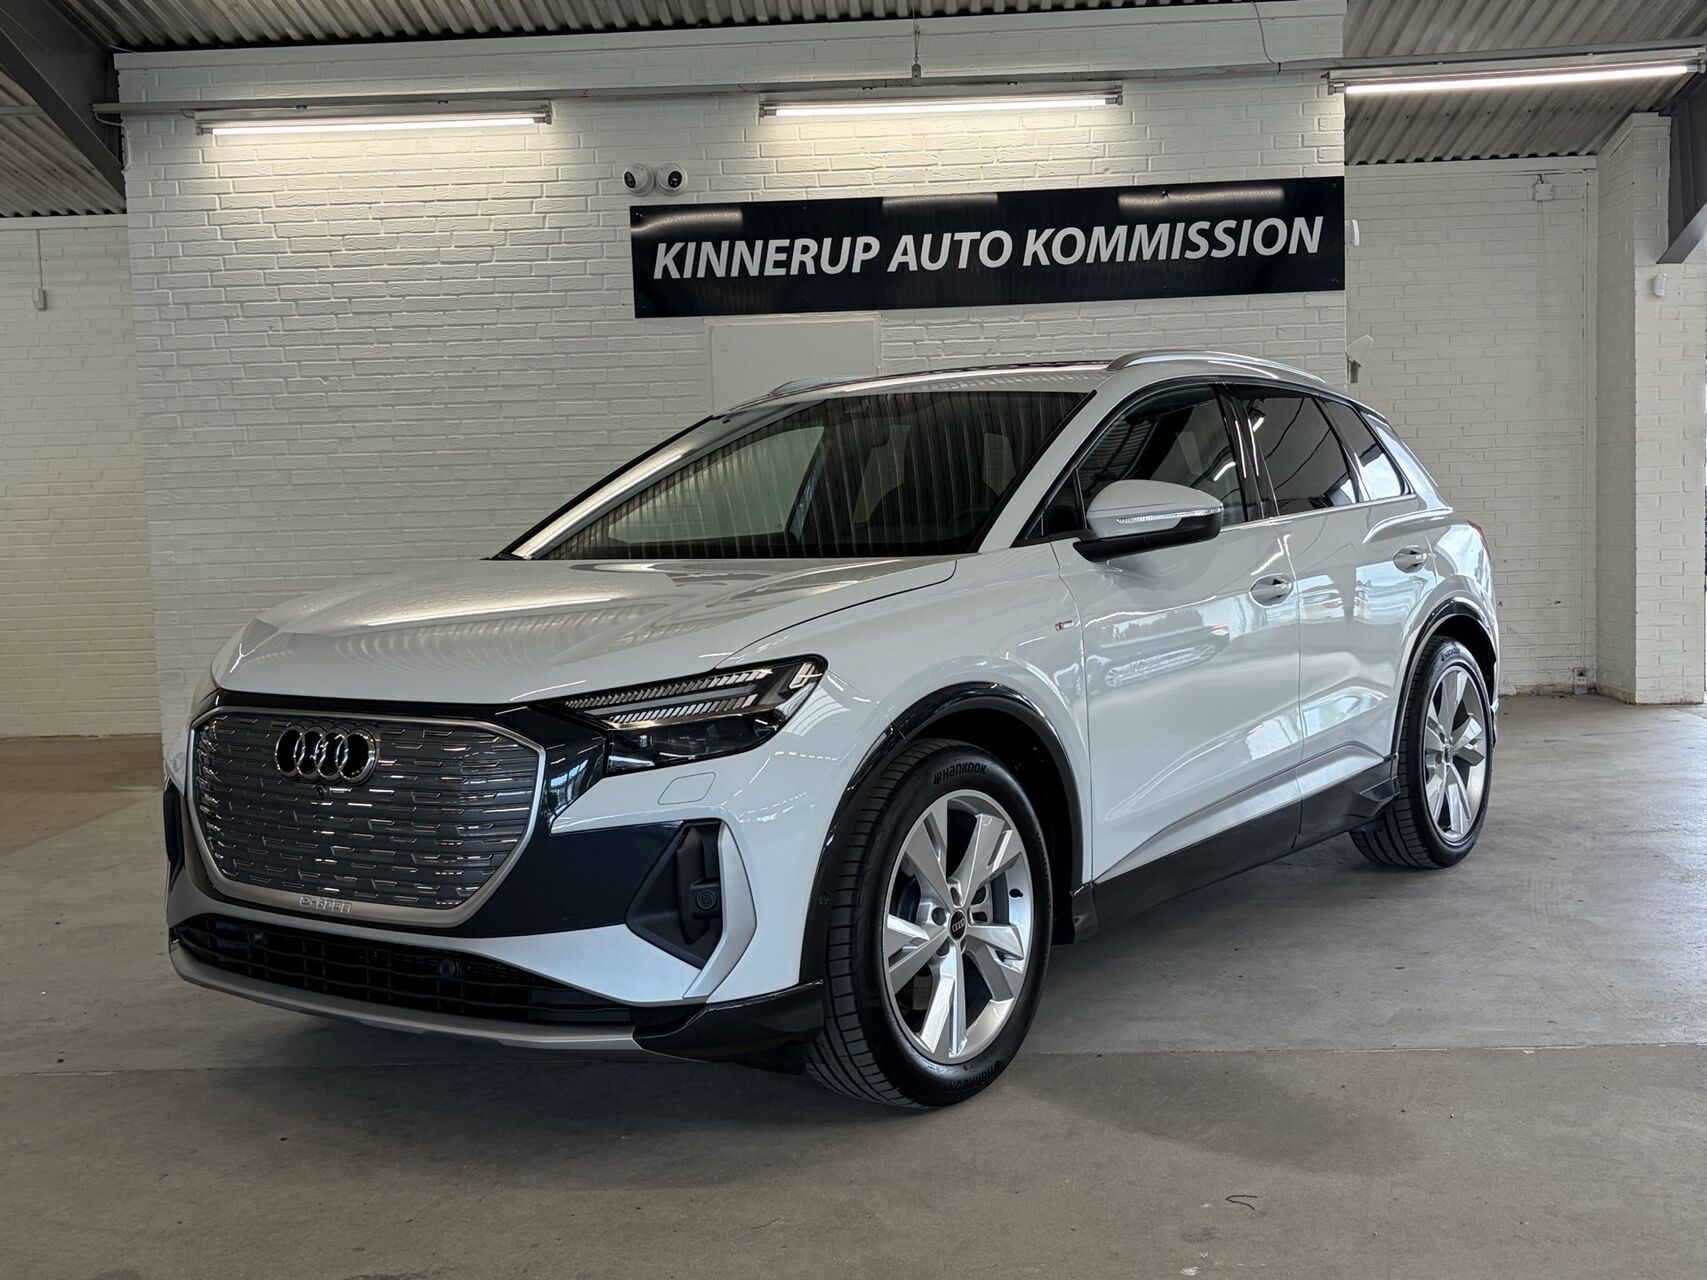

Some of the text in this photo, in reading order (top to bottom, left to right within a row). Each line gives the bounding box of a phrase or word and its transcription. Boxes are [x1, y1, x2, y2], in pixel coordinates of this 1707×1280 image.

[653, 216, 1324, 279] KINNERUP AUTO KOMMISSION
